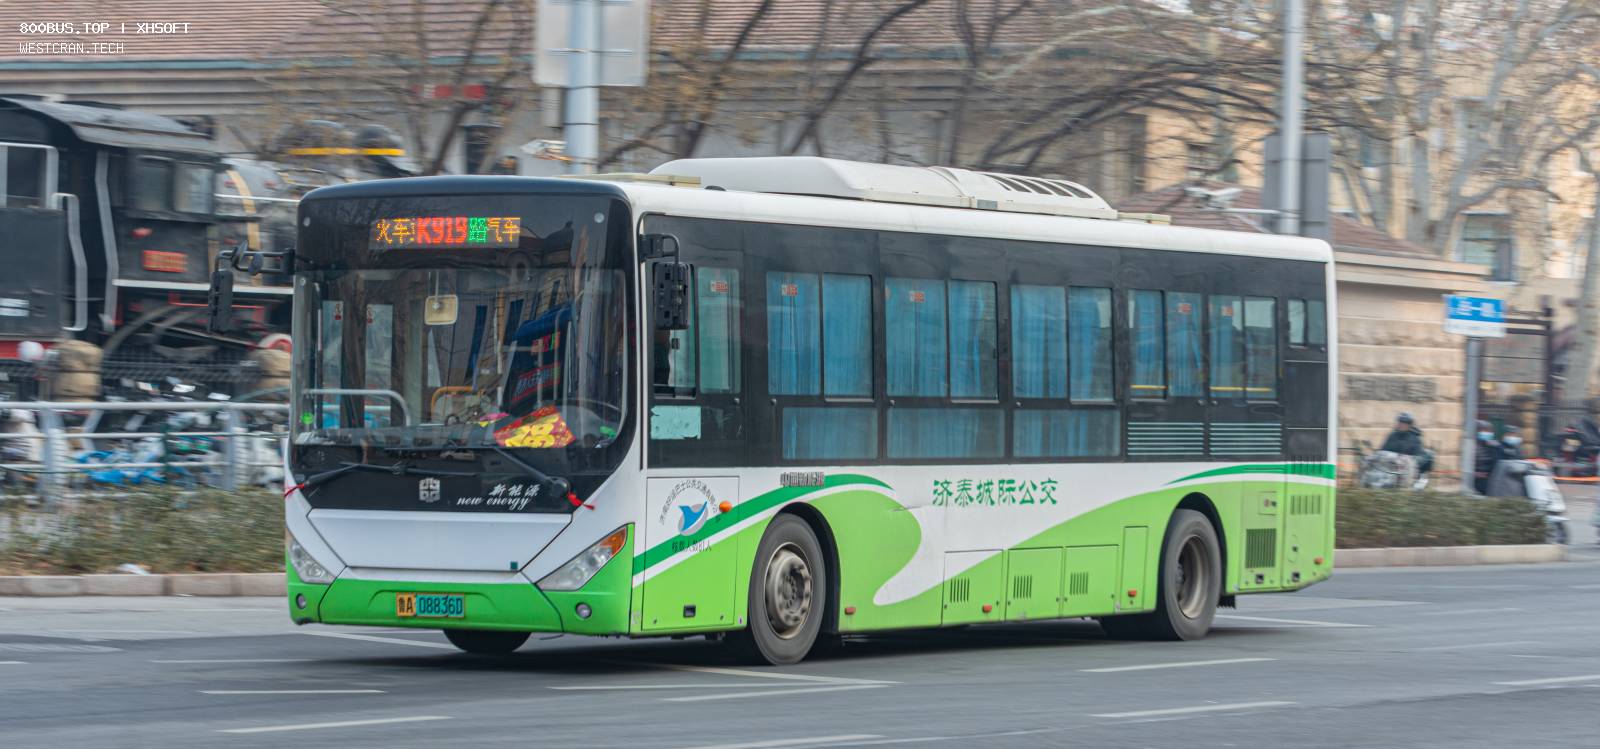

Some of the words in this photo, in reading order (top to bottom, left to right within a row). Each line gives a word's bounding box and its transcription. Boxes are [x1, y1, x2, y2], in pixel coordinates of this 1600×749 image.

[488, 483, 541, 497] 新能源
[932, 477, 1058, 507] 济泰城际公交
[456, 496, 482, 506] new
[486, 496, 530, 511] energy
